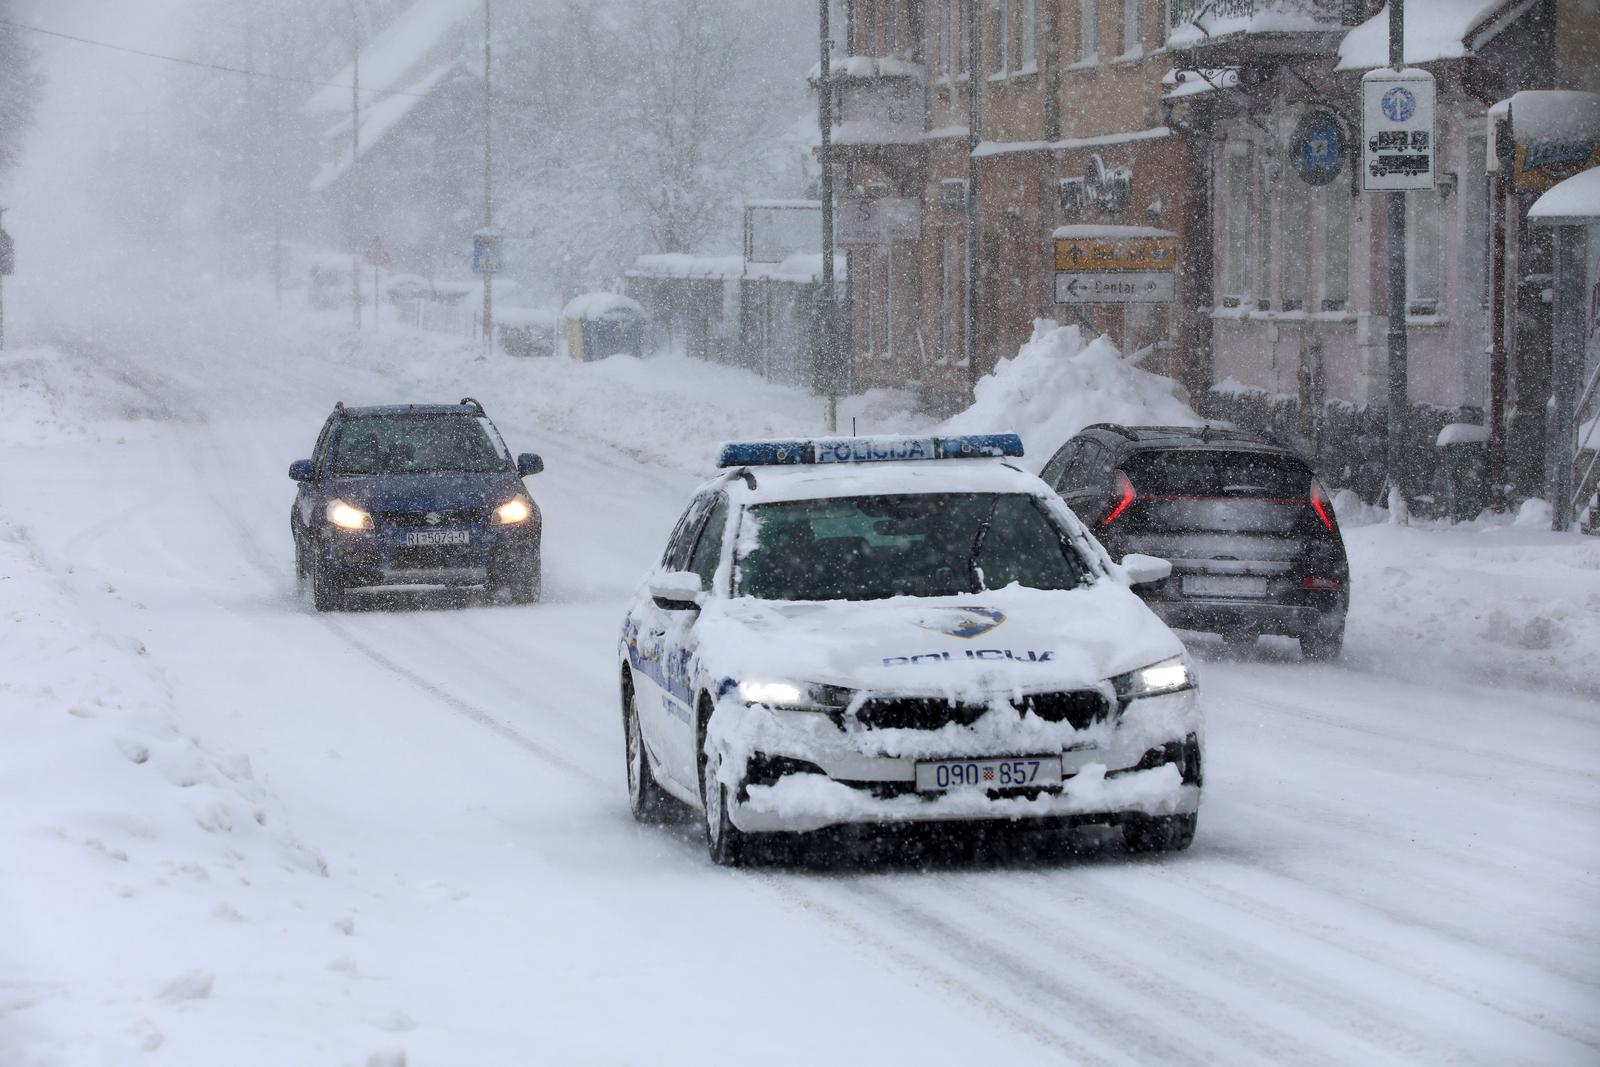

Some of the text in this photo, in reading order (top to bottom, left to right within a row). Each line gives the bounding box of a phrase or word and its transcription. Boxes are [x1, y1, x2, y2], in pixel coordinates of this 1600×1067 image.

[819, 440, 925, 461] POLICIJA
[936, 761, 1041, 788] 090 857
